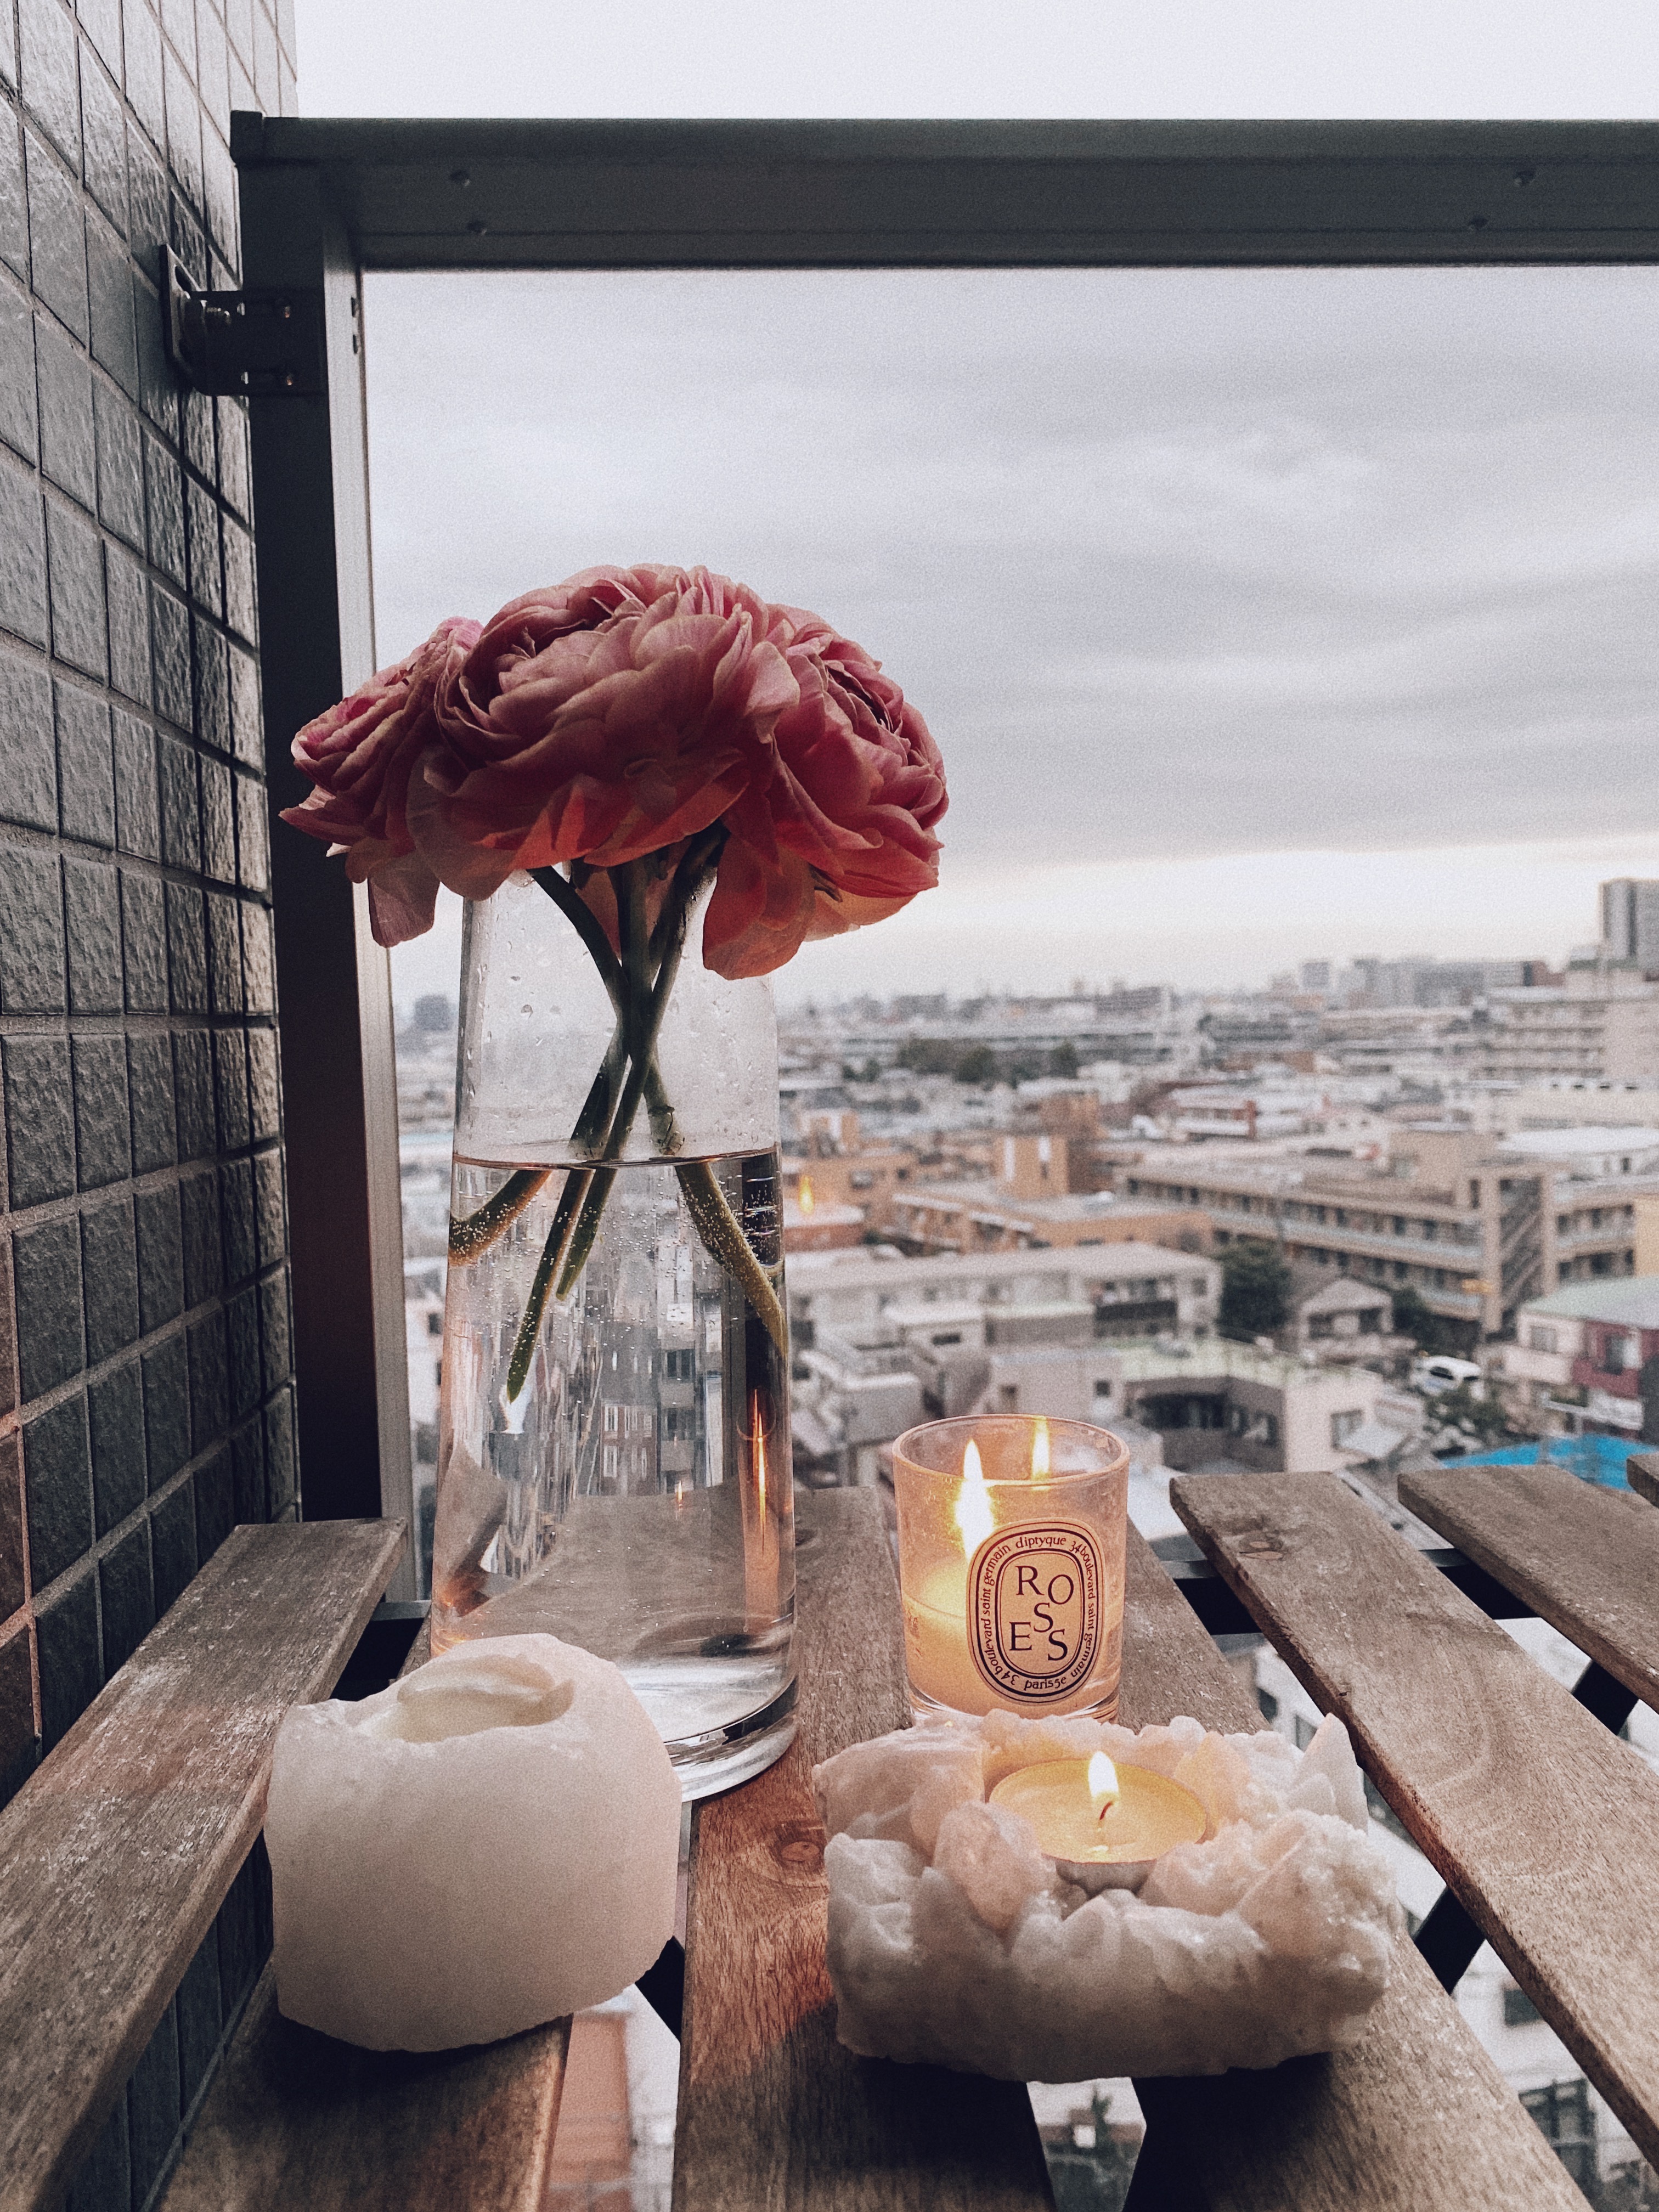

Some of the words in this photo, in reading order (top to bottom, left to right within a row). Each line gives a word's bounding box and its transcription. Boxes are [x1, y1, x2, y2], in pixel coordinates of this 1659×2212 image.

[984, 1545, 1012, 1587] germain
[980, 1588, 991, 1616] saint
[1015, 1536, 1066, 1549] diptyque
[1071, 1633, 1092, 1678] germain
